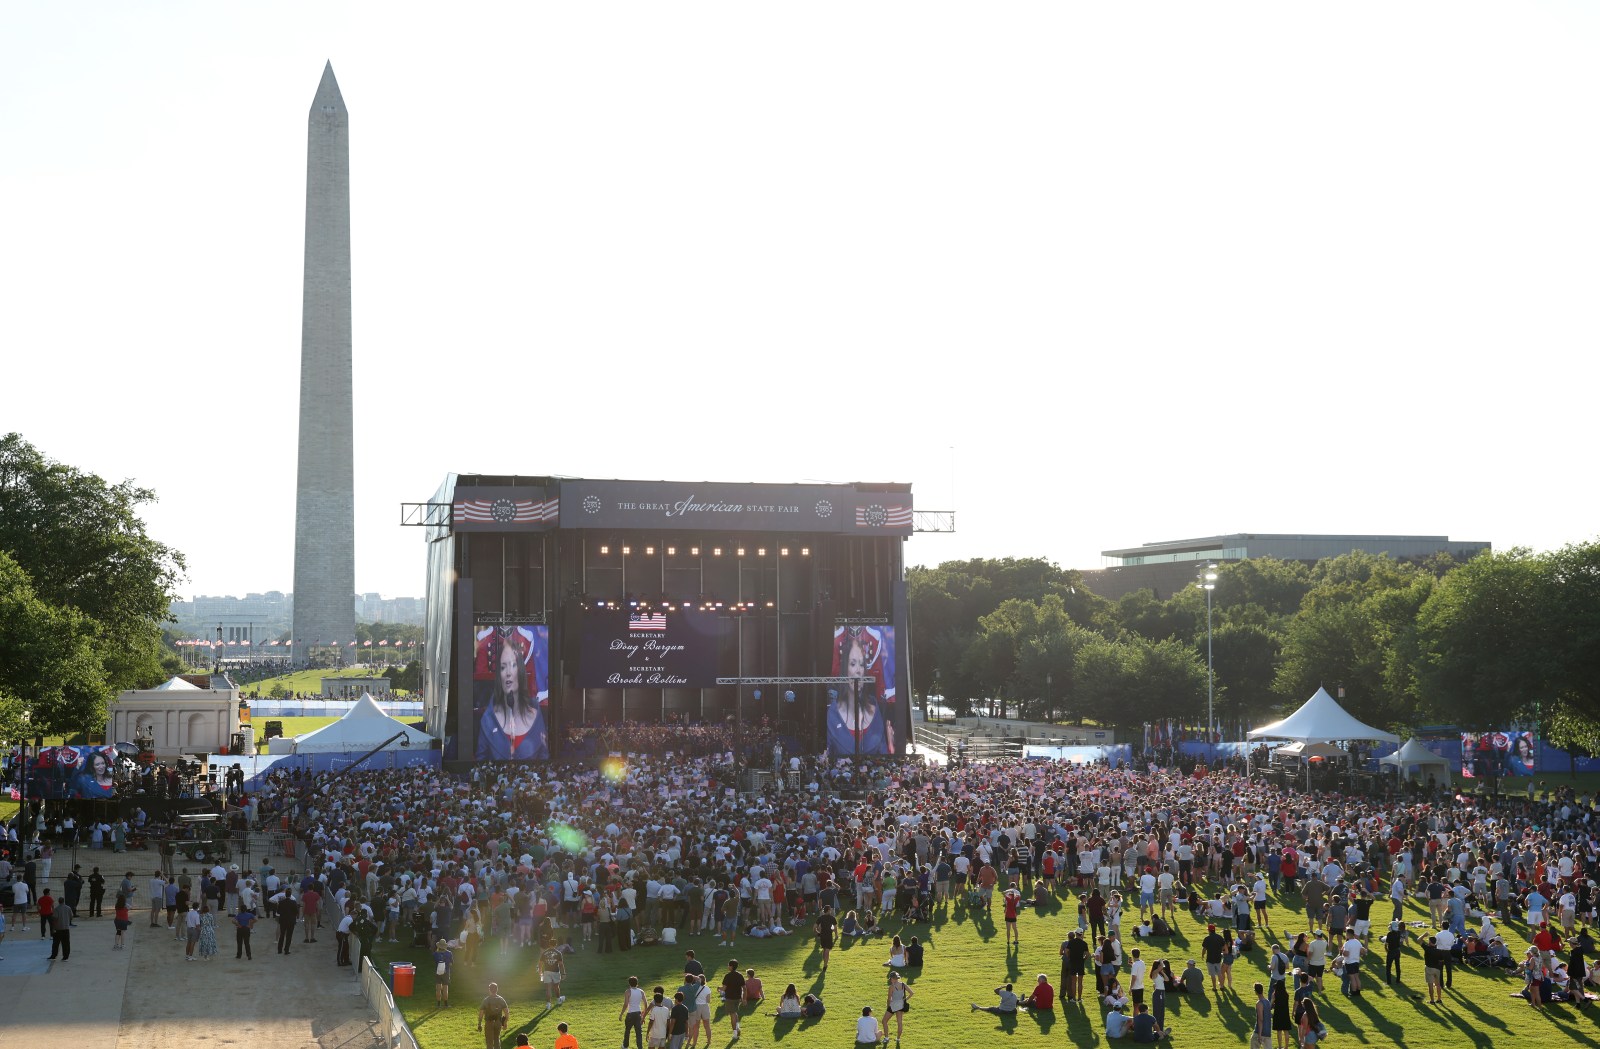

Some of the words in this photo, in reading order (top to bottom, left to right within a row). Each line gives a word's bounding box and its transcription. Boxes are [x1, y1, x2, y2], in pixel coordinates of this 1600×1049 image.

[618, 502, 636, 510] THE
[639, 502, 670, 510] GREAT
[665, 494, 743, 517] American
[746, 504, 775, 512] STATE
[778, 505, 799, 513] FAIR
[609, 639, 639, 659] Doug
[643, 639, 685, 659] Burgum
[607, 673, 643, 684] Brooke
[646, 673, 687, 684] Rollins
